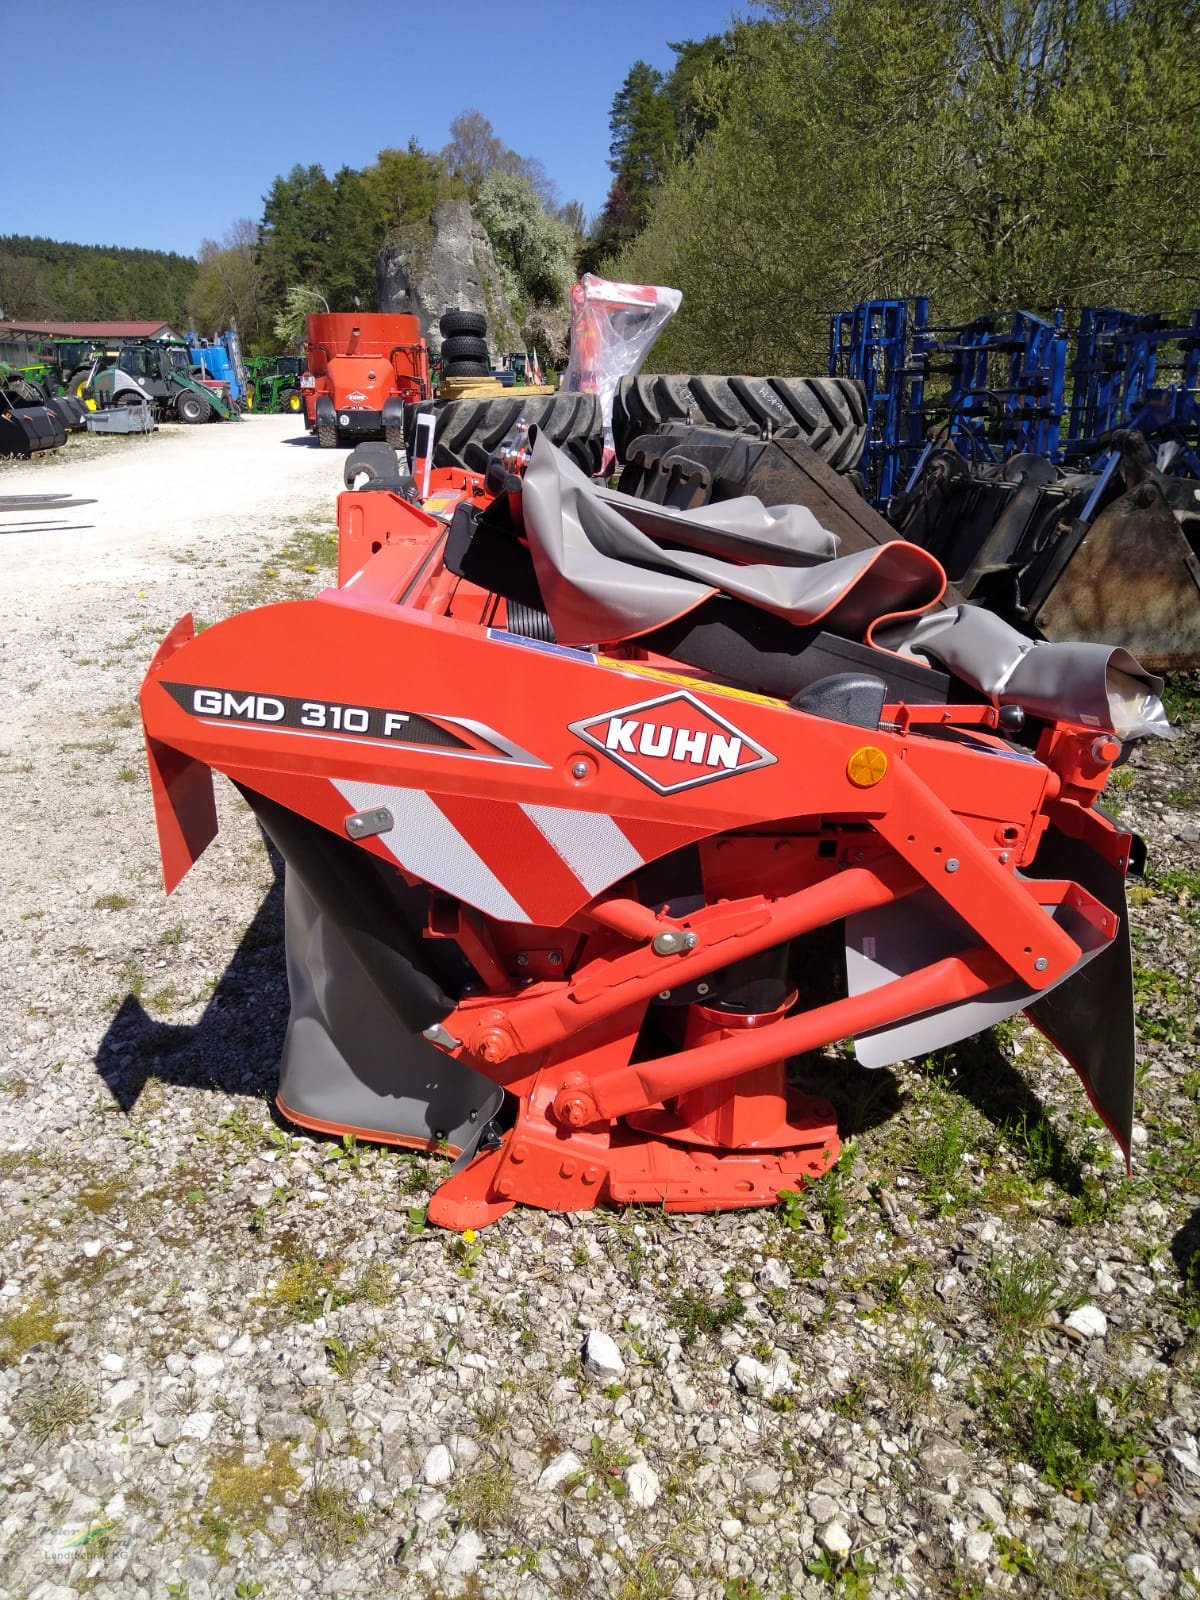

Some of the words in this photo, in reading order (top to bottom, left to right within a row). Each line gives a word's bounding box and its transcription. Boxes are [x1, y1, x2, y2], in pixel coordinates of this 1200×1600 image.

[193, 689, 285, 722] GMD
[301, 702, 369, 733] 310
[384, 712, 410, 736] F
[605, 717, 742, 769] KUHN
